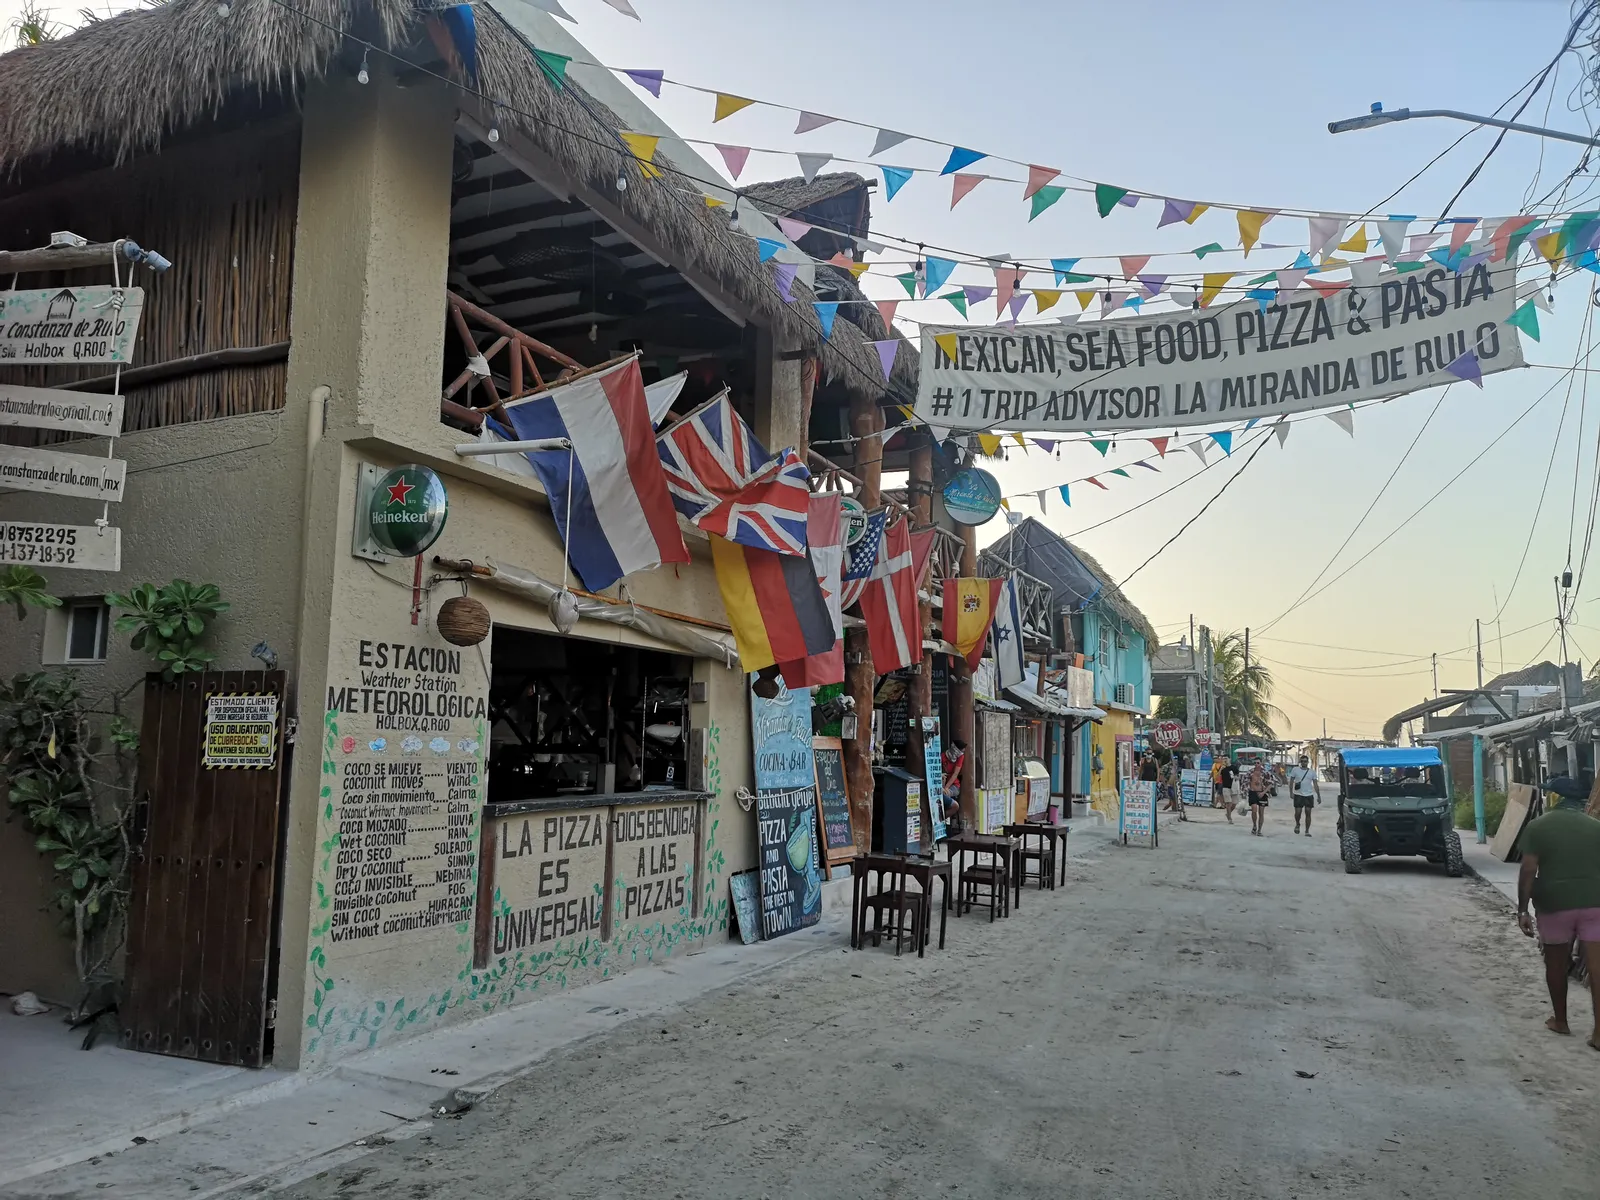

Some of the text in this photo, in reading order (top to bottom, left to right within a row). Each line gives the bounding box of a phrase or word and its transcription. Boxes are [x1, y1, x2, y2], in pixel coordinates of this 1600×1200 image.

[1068, 330, 1126, 372] SEA
[1135, 316, 1228, 367] FOOD,
[1235, 297, 1335, 356] PIZZA
[1347, 285, 1372, 336] &
[1381, 262, 1489, 330] PASTA
[7, 319, 73, 339] Constanza
[74, 318, 90, 337] de
[24, 343, 65, 359] Holbox
[980, 389, 1038, 421] TRIP
[1042, 385, 1161, 422] ADVISOR
[1173, 381, 1207, 416] LA
[1219, 358, 1360, 412] MIRANDA
[1370, 346, 1407, 386] DE
[1414, 321, 1500, 376] RULO
[372, 510, 428, 524] Heineken
[359, 640, 461, 674] ESTACION
[361, 670, 457, 693] Weather Station
[210, 697, 275, 706] ESTIMADO CLIENTE
[327, 686, 486, 719] METEOROLOGICA
[211, 725, 270, 734] USO OBLIGATORIO
[1158, 729, 1179, 740] ALTO
[210, 736, 258, 746] DE CUBREBOCAS
[344, 762, 478, 776] COCO SE MUEVE VIENTO
[760, 750, 807, 772] COCINA BAR
[343, 774, 471, 790] coconut moves Wind
[342, 788, 477, 805] Coco sin movimiento Calma
[340, 806, 369, 819] Coconut
[447, 802, 469, 813] Calm
[339, 820, 363, 835] COCO
[366, 818, 407, 832] MOJADO
[615, 806, 695, 843] DIOS BENDIGA
[760, 818, 787, 846] PIZZA
[339, 827, 468, 850] Wet coconut RAIN
[502, 814, 602, 859] LA PIZZA
[337, 840, 472, 864] COCO SECO SOLEADO
[637, 842, 677, 878] A LAS
[765, 849, 779, 862] AND
[336, 865, 358, 880] Dry
[361, 858, 406, 877] coconut
[538, 858, 569, 898] ES
[762, 865, 788, 895] PASTA
[334, 893, 374, 911] invisible
[448, 883, 465, 895] FOG
[335, 879, 361, 895] COCO
[625, 876, 685, 920] PIZZAS
[331, 895, 473, 927] SIN COCO HURACAN
[764, 896, 774, 910] THE
[493, 895, 600, 955] UNIVERSAL
[764, 906, 792, 935] TOWN
[331, 922, 379, 943] Without
